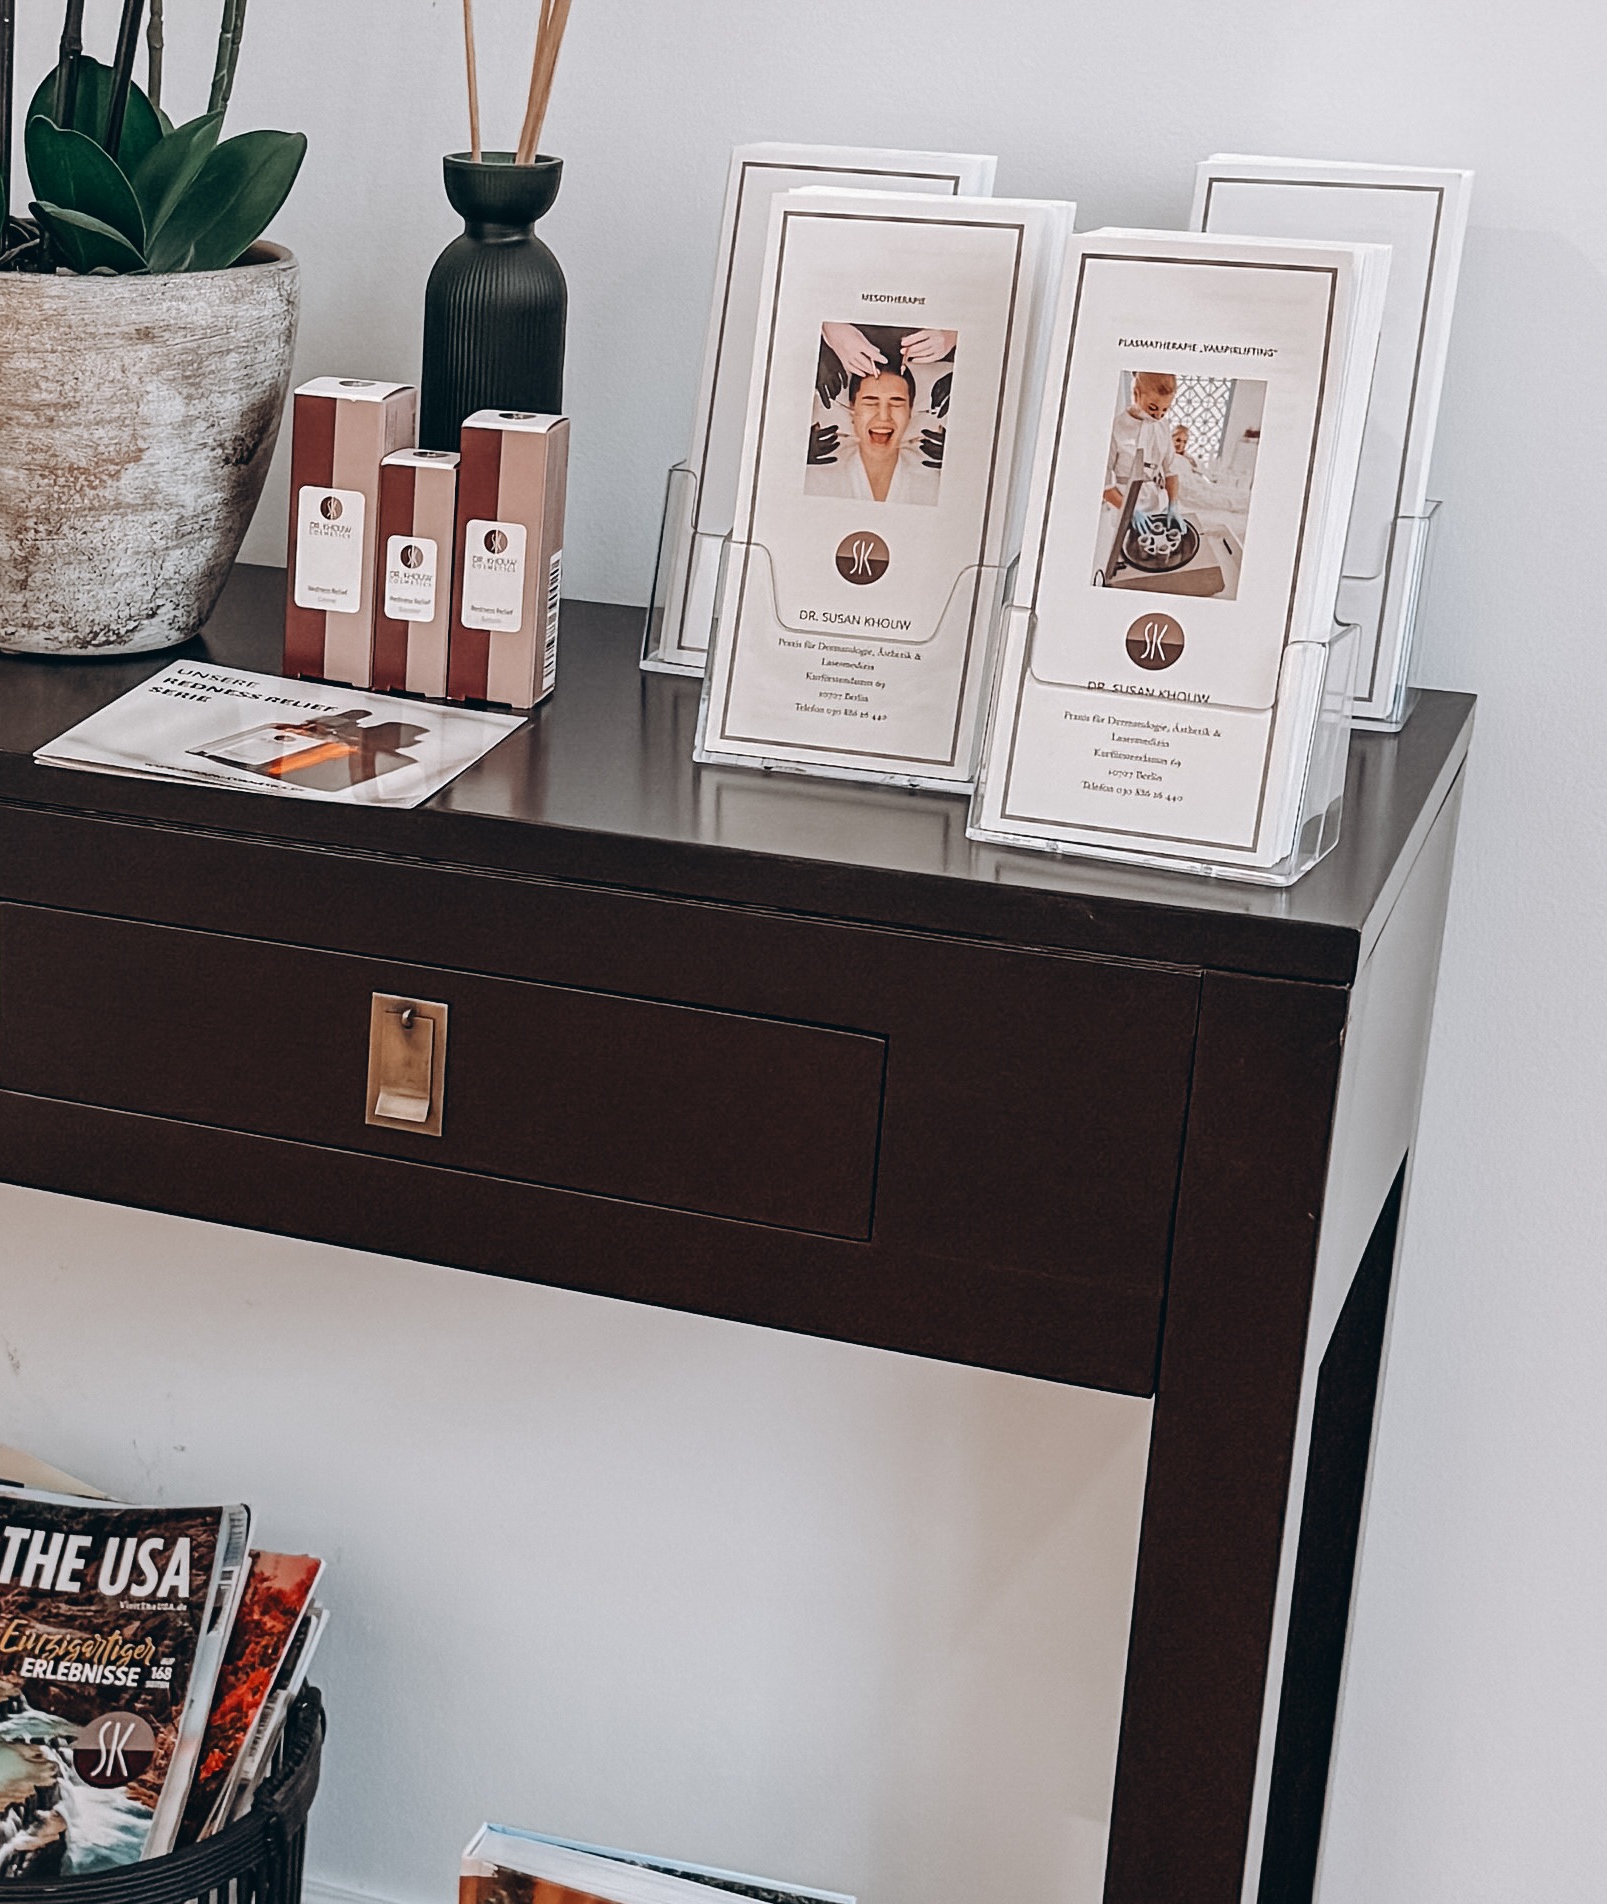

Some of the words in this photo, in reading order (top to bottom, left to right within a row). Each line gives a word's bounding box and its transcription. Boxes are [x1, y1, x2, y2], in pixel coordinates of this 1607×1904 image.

[1118, 338, 1198, 353] PLASMATHERAPIE
[799, 609, 818, 622] DR.
[822, 612, 861, 625] SUSAN
[864, 616, 912, 631] KHOUW
[778, 637, 802, 649] Praxis
[804, 641, 816, 649] für
[914, 653, 922, 661] &
[821, 657, 875, 671] Lasermedizin
[177, 668, 261, 689] UNSERE
[148, 686, 212, 704] SERIE
[163, 677, 262, 700] REDNESS
[264, 696, 339, 713] RELIEF
[844, 693, 869, 703] Berlin
[1112, 684, 1155, 697] SUSAN
[1158, 688, 1210, 703] KHOUW
[795, 703, 825, 716] Telefon
[1064, 711, 1090, 723] Praxis
[1092, 714, 1105, 724] für
[1107, 716, 1170, 733] Dermatologie,
[1172, 722, 1210, 737] Ästhetik
[1213, 729, 1222, 738] &
[1111, 732, 1170, 748] Lasermedizin
[1136, 770, 1163, 782] Berlin
[1081, 780, 1115, 794] Telefon
[97, 1536, 191, 1598] USA
[20, 1657, 142, 1688] ERLEBNISSE
[151, 1666, 172, 1680] 168
